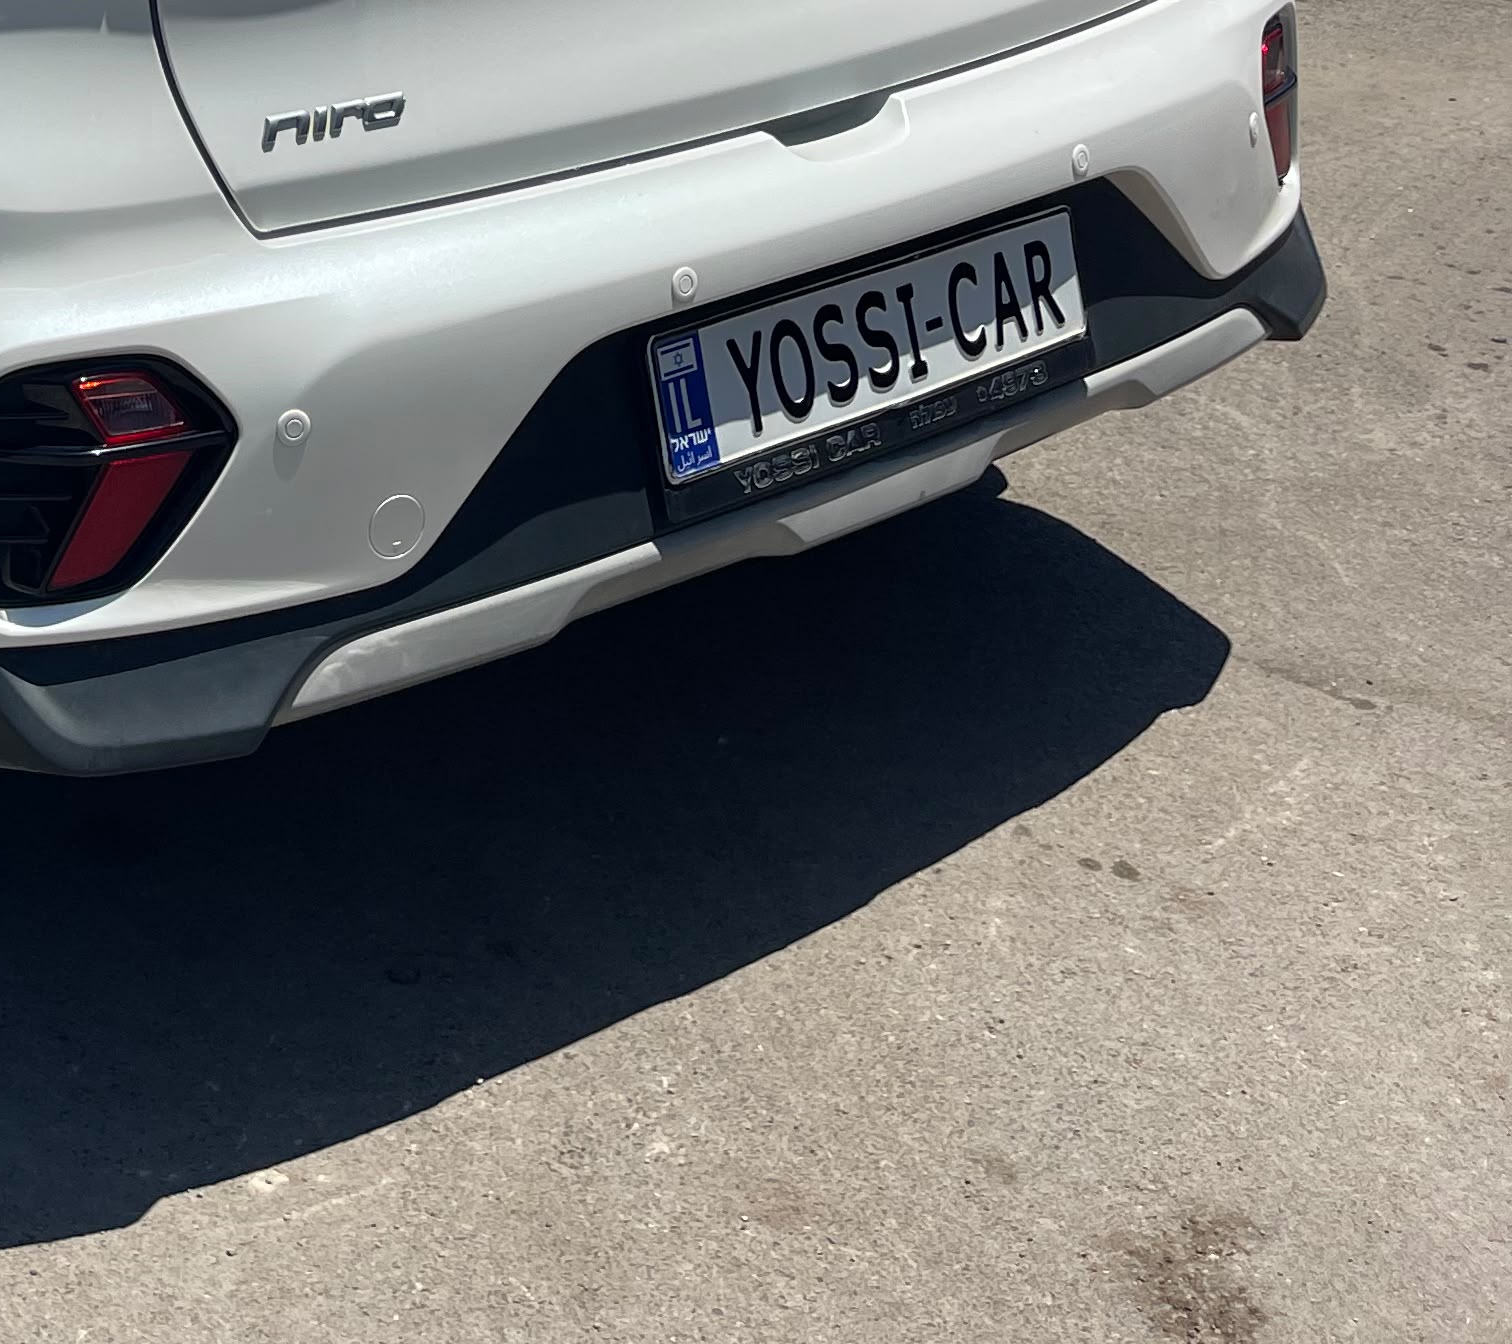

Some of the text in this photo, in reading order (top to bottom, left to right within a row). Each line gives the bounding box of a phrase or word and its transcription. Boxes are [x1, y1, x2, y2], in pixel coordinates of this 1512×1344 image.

[725, 239, 1066, 437] YOSSI-CAR
[667, 378, 702, 433] IL
[670, 427, 712, 454] ישראל
[733, 422, 883, 495] YOSSI CAR
